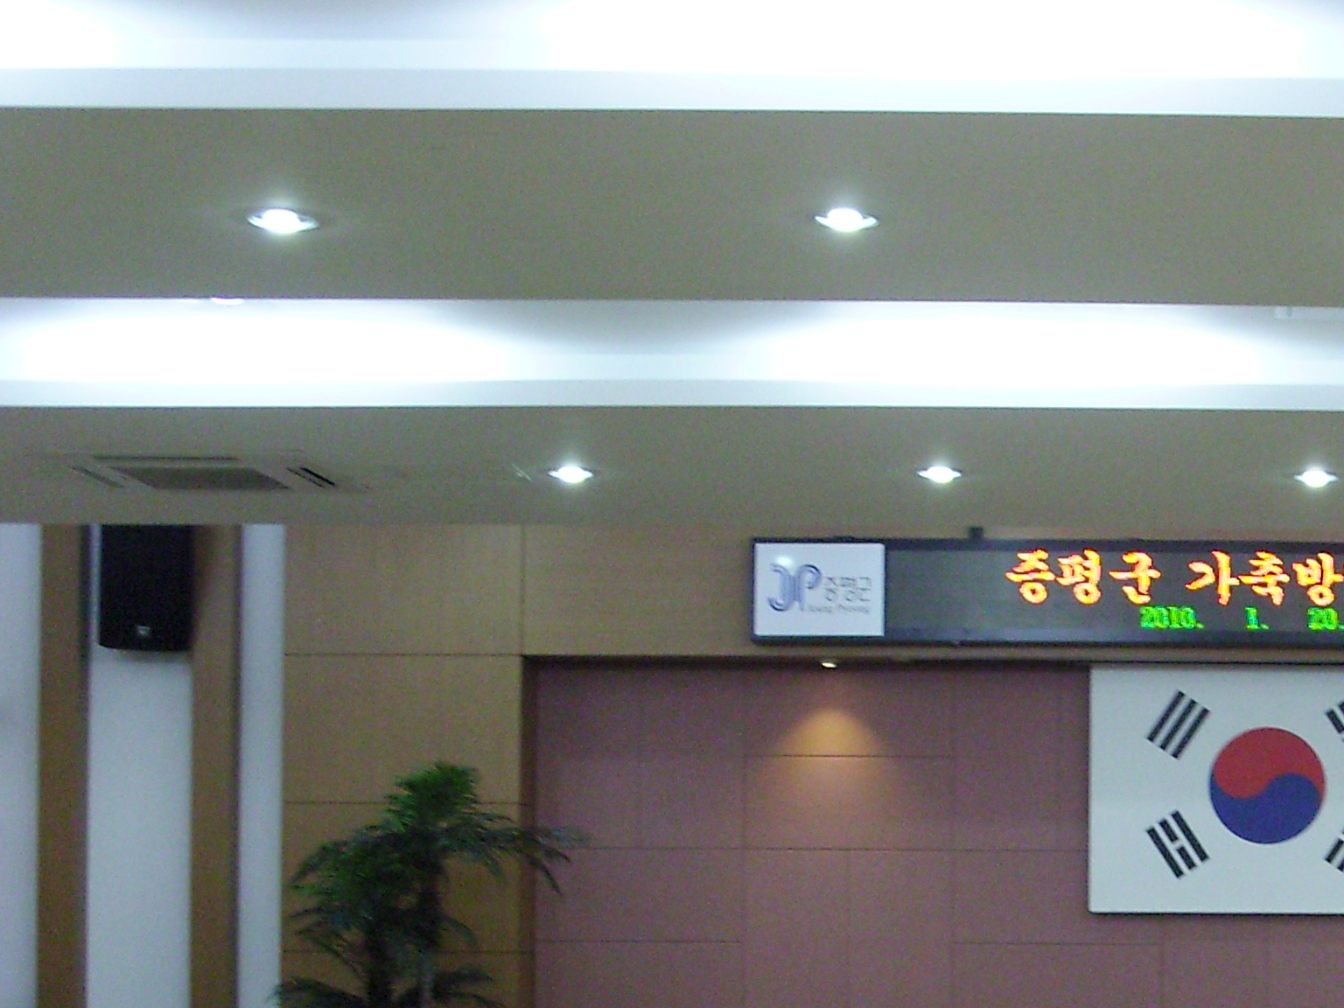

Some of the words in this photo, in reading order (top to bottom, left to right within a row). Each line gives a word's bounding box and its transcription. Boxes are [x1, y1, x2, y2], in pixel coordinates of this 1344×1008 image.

[1005, 549, 1162, 605] 증평군
[1138, 605, 1205, 630] 2010.
[1244, 606, 1270, 631] 1.
